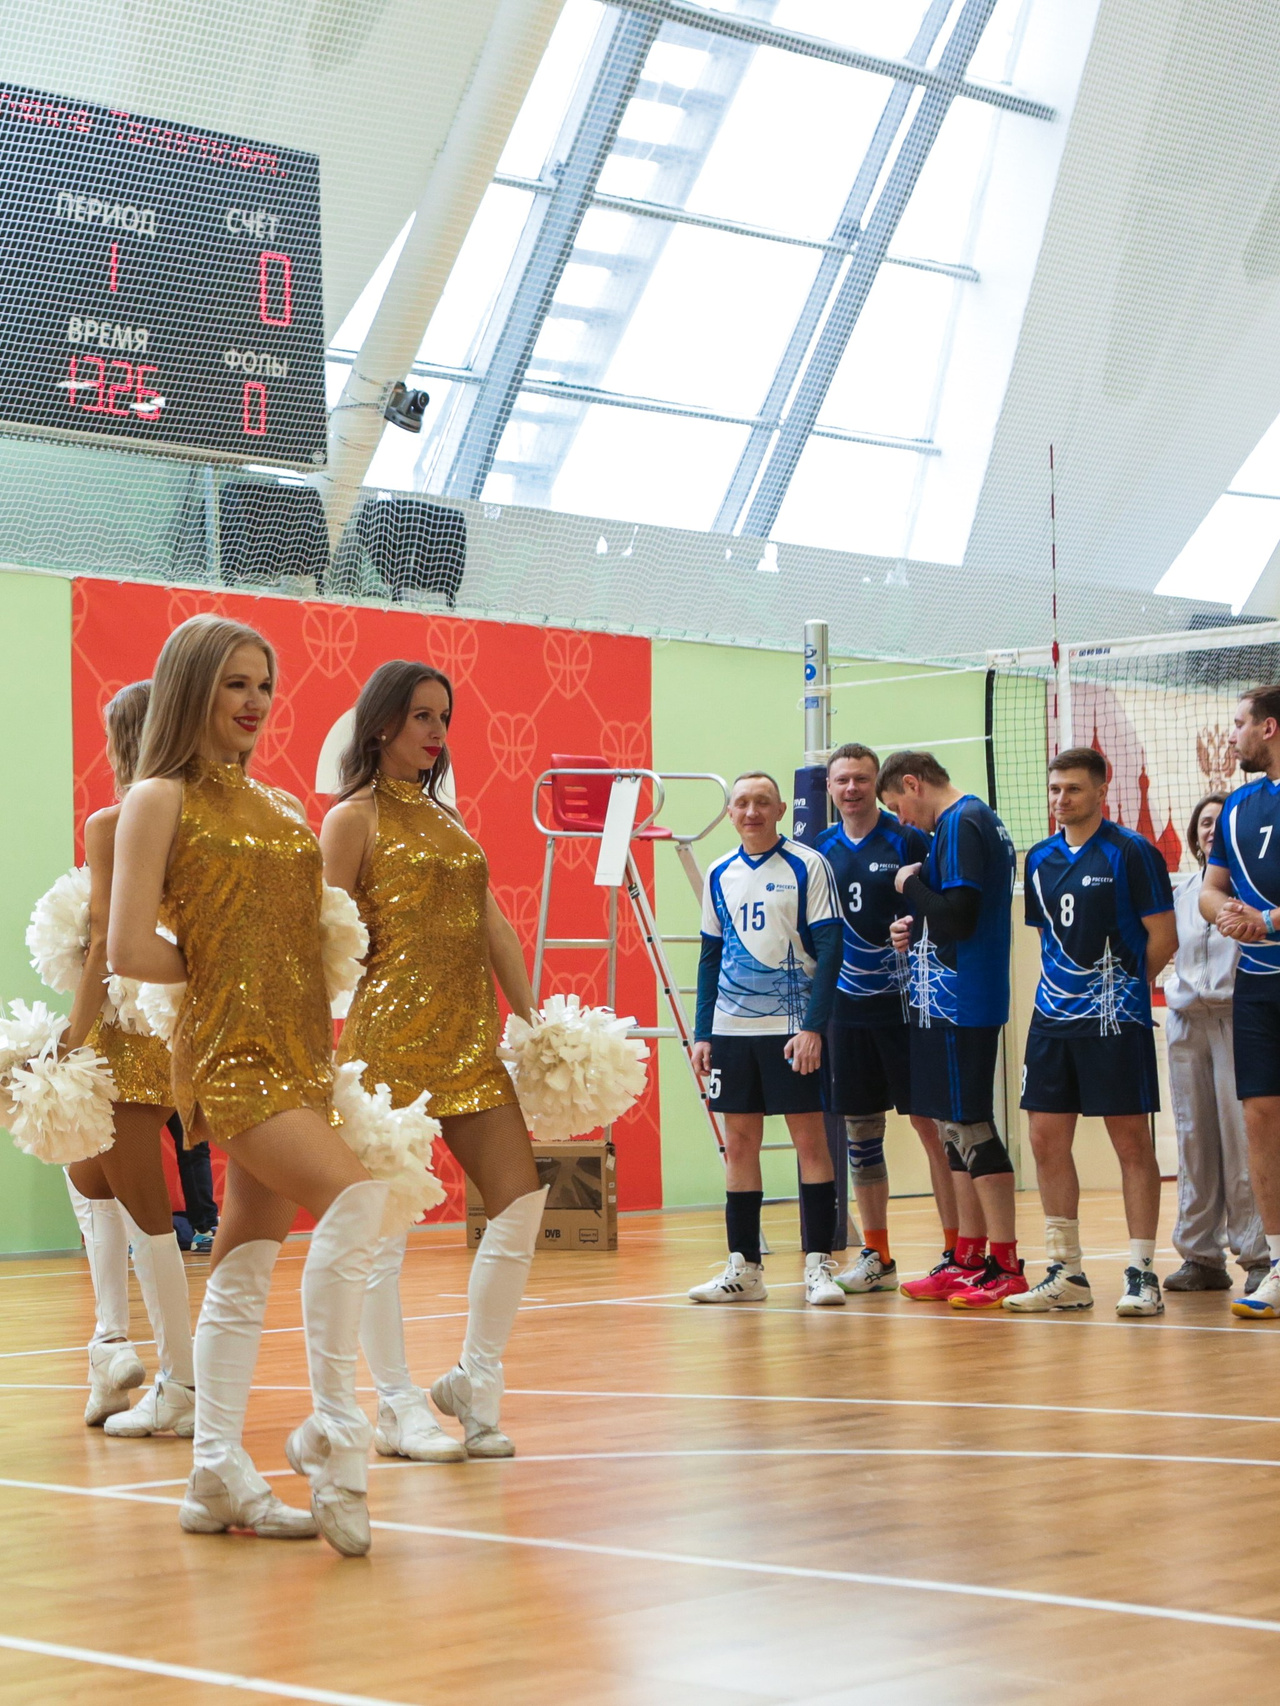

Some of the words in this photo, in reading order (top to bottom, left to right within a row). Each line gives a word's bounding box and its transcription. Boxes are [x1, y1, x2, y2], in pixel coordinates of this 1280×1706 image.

[56, 191, 157, 240] ПЕРИОД
[110, 242, 118, 293] 1
[259, 251, 292, 327] 0
[67, 315, 149, 354] ВРЕМЯ
[224, 347, 288, 379] ФОЛЫ
[243, 381, 267, 436] 0
[1258, 825, 1273, 859] 7
[848, 881, 863, 913] 3
[1060, 893, 1075, 927] 8
[739, 901, 766, 932] 15
[709, 1068, 722, 1099] 5
[544, 1229, 561, 1239] DVB
